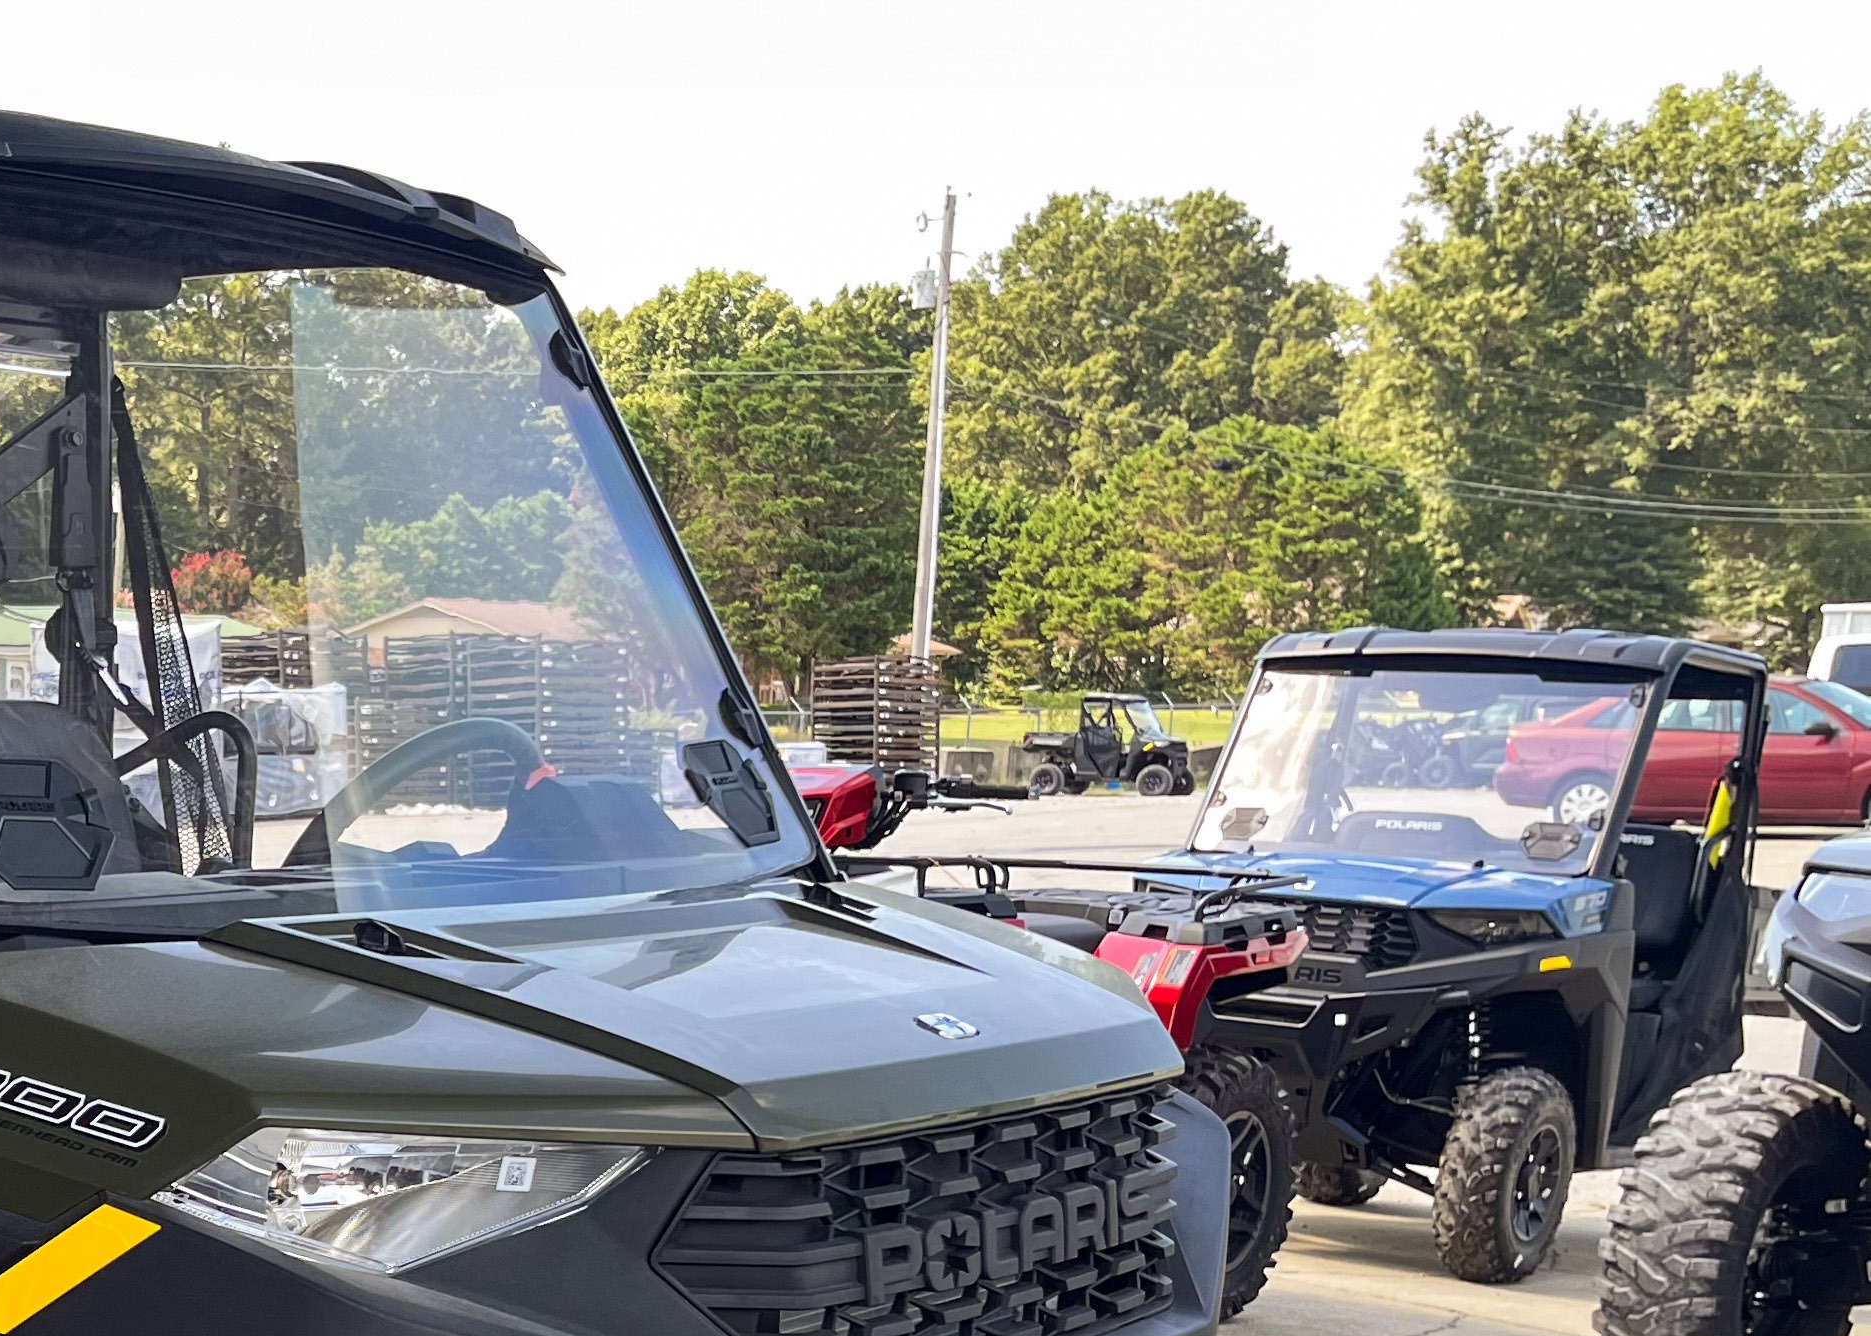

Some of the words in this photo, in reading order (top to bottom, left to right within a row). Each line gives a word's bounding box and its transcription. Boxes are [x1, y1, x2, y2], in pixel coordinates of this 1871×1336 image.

[1375, 818, 1443, 831] POLARIS
[87, 1147, 141, 1169] CAM
[863, 1164, 1156, 1306] POLARIS
